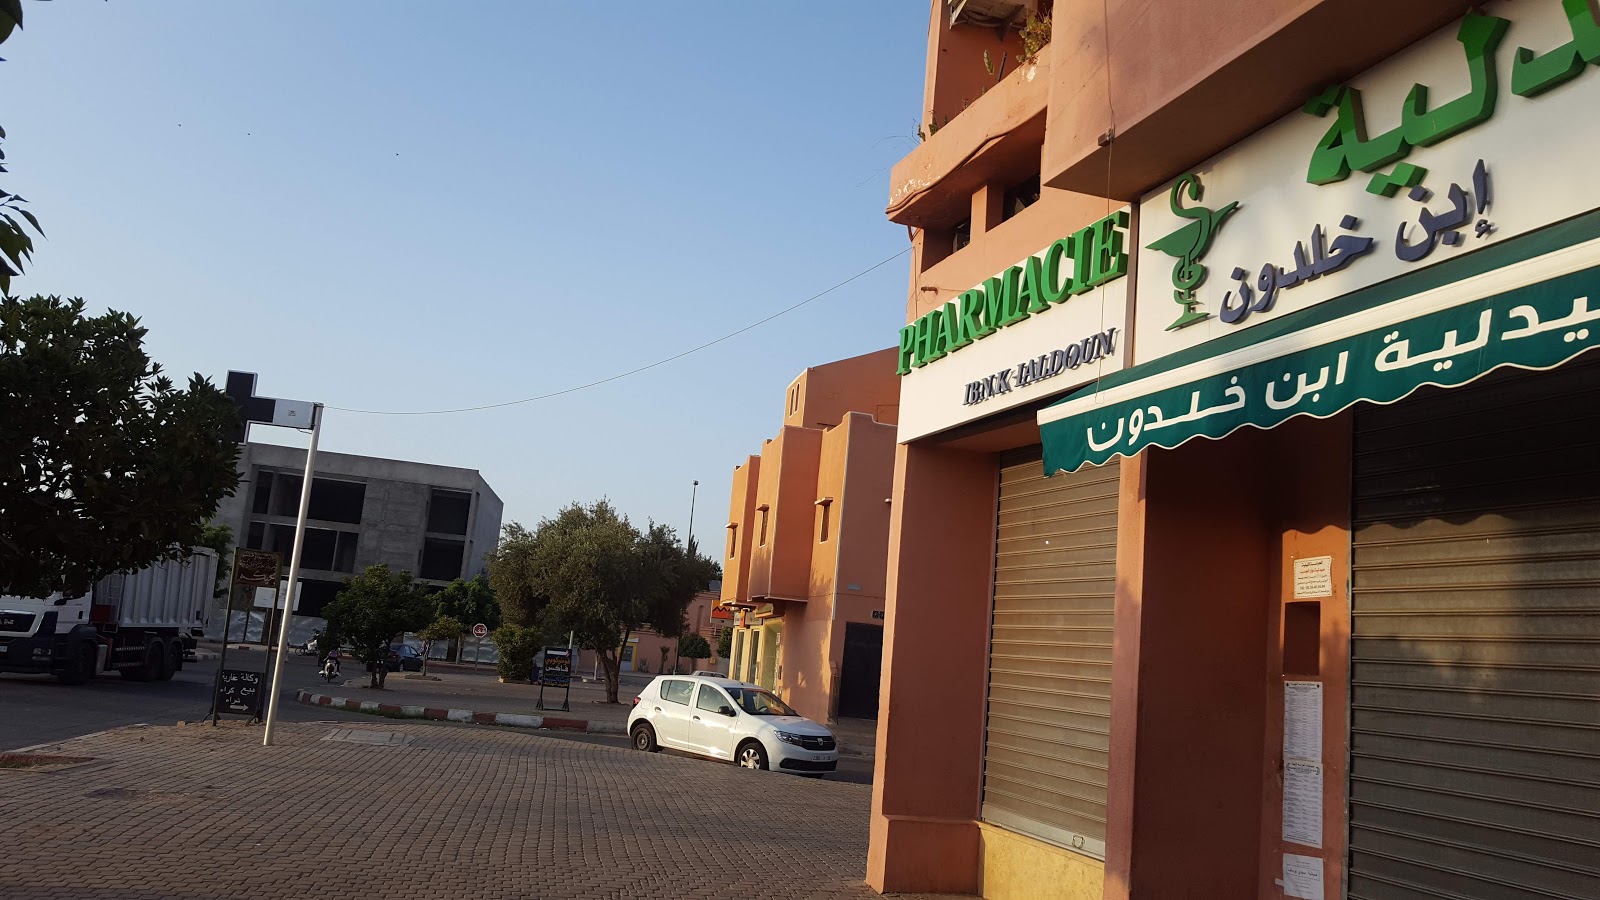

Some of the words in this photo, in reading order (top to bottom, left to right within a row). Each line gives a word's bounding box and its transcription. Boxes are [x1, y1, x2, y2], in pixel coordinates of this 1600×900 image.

[1302, 0, 1600, 198] دلية
[1395, 158, 1493, 262] إبن
[896, 210, 1130, 376] PHARMACIE
[1219, 214, 1373, 324] خلدون
[1375, 294, 1600, 372] يدلية
[1086, 375, 1246, 452] خلدون
[1264, 350, 1349, 410] ابن
[220, 686, 235, 695] كراء
[225, 696, 241, 705] شراء
[240, 673, 259, 684] وكالة
[240, 687, 256, 696] بيع
[545, 664, 569, 672] فاكس
